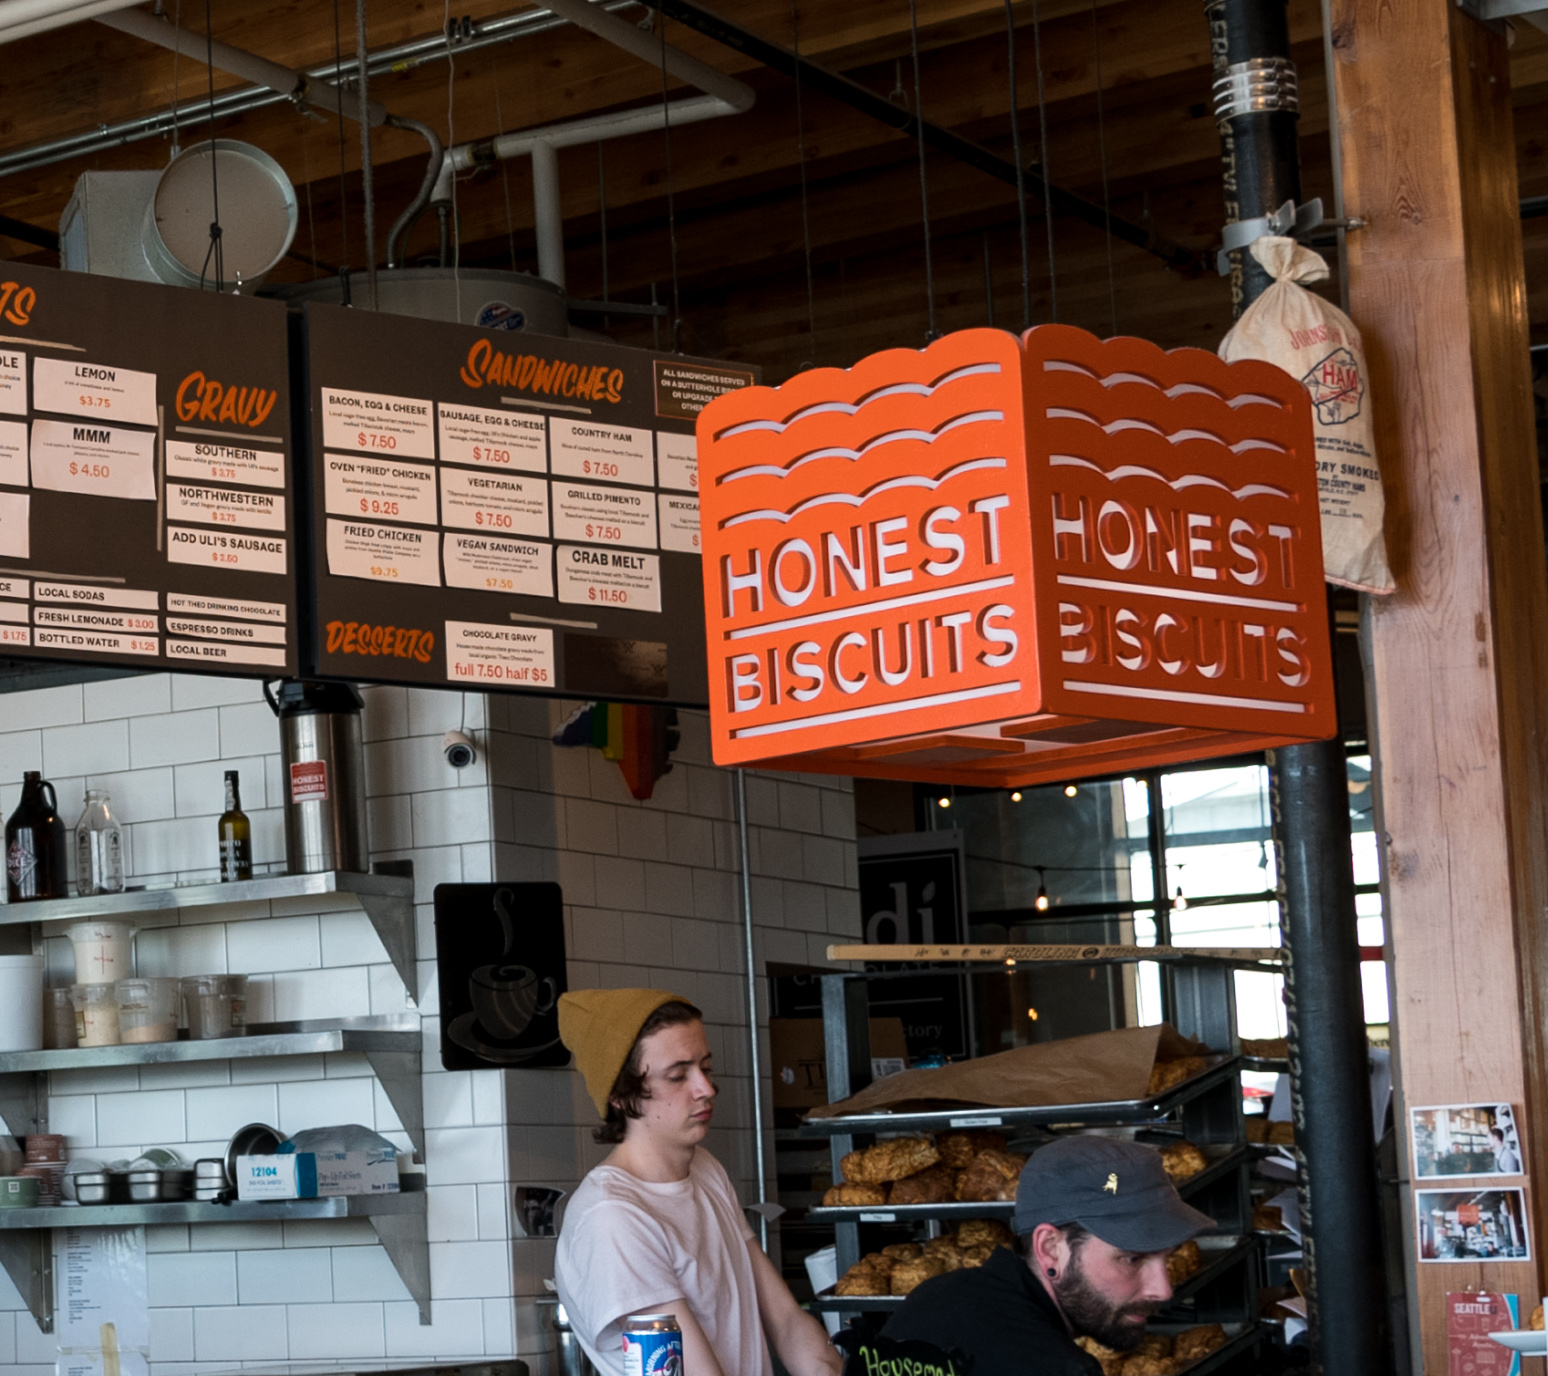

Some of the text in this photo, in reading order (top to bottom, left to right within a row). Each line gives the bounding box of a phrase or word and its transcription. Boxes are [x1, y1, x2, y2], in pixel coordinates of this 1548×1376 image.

[75, 366, 116, 382] LEMON
[461, 338, 624, 403] SANDWICHES
[663, 369, 745, 386] ALL SANDWICHES SERVED
[1322, 363, 1358, 393] HAM
[677, 382, 719, 394] BUTTERHOLE
[79, 395, 111, 408] $3.75
[175, 371, 277, 427] GRAVY
[329, 395, 427, 416] BACON, EGG & CHEESE
[485, 415, 502, 425] EGG
[504, 418, 510, 426] &
[511, 419, 545, 431] CHEESE
[73, 427, 111, 444] MMM
[571, 427, 632, 443] COUNTRY HAM
[195, 444, 257, 461] SOUTHERN
[330, 462, 355, 472] OVEN
[392, 469, 431, 481] CHICKEN
[468, 478, 523, 492] VEGETARIAN
[179, 487, 274, 507] NORTHWESTERN
[567, 490, 641, 506] GRILLED PIMENTO
[669, 501, 700, 511] MEXICA
[172, 532, 283, 553] ADD ULI'S SAUSAGE
[344, 525, 422, 543] FRIED CHICKEN
[1052, 492, 1301, 590] HONEST
[457, 539, 538, 556] VEGAN SANDWICH
[572, 550, 646, 570] CRAB MELT
[722, 496, 1010, 619] HONEST
[370, 566, 398, 578] $9.75
[38, 588, 105, 602] LOCAL SODAS
[171, 598, 185, 606] HOT
[207, 602, 239, 612] DRINKING
[38, 612, 124, 627] FRESH LEMONADE
[171, 622, 254, 637] ESPRESSO DRINKS
[462, 629, 537, 643] CHOCOLATE GRAVY
[39, 633, 120, 648] BOTTLED WATER
[326, 620, 434, 663] DESSERTS
[1059, 601, 1312, 689] BISCUITS
[170, 645, 227, 657] LOCAL BEER
[726, 603, 1018, 714] BISCUITS
[454, 662, 548, 682] full 7.50 half $5
[251, 1167, 277, 1177] 12104
